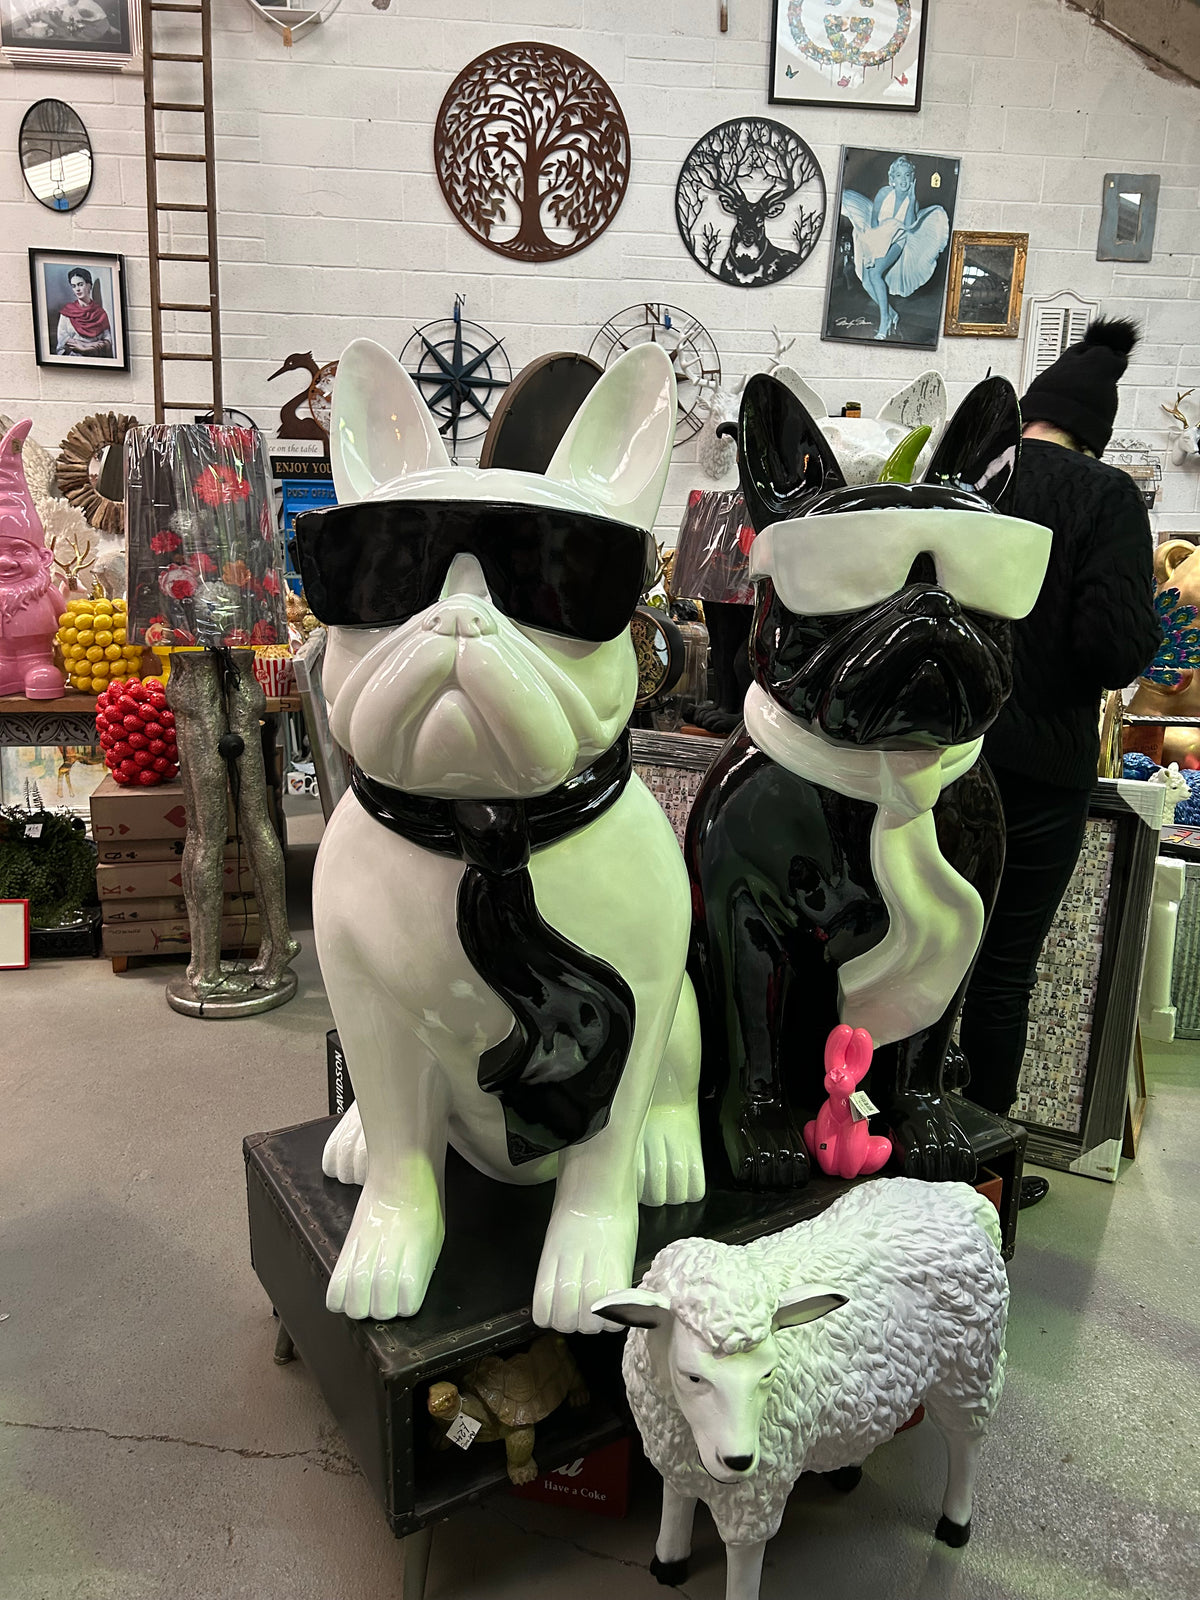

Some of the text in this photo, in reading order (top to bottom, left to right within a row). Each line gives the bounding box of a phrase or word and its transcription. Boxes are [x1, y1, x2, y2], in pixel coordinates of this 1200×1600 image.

[455, 293, 466, 306] N
[644, 303, 660, 324] N
[287, 444, 299, 452] the
[300, 445, 318, 453] table
[275, 462, 309, 474] ENJOY
[287, 487, 335, 498] POST OFFIC
[102, 885, 121, 895] K
[108, 912, 125, 920] A
[544, 1480, 570, 1494] Have
[580, 1487, 607, 1501] Coke
